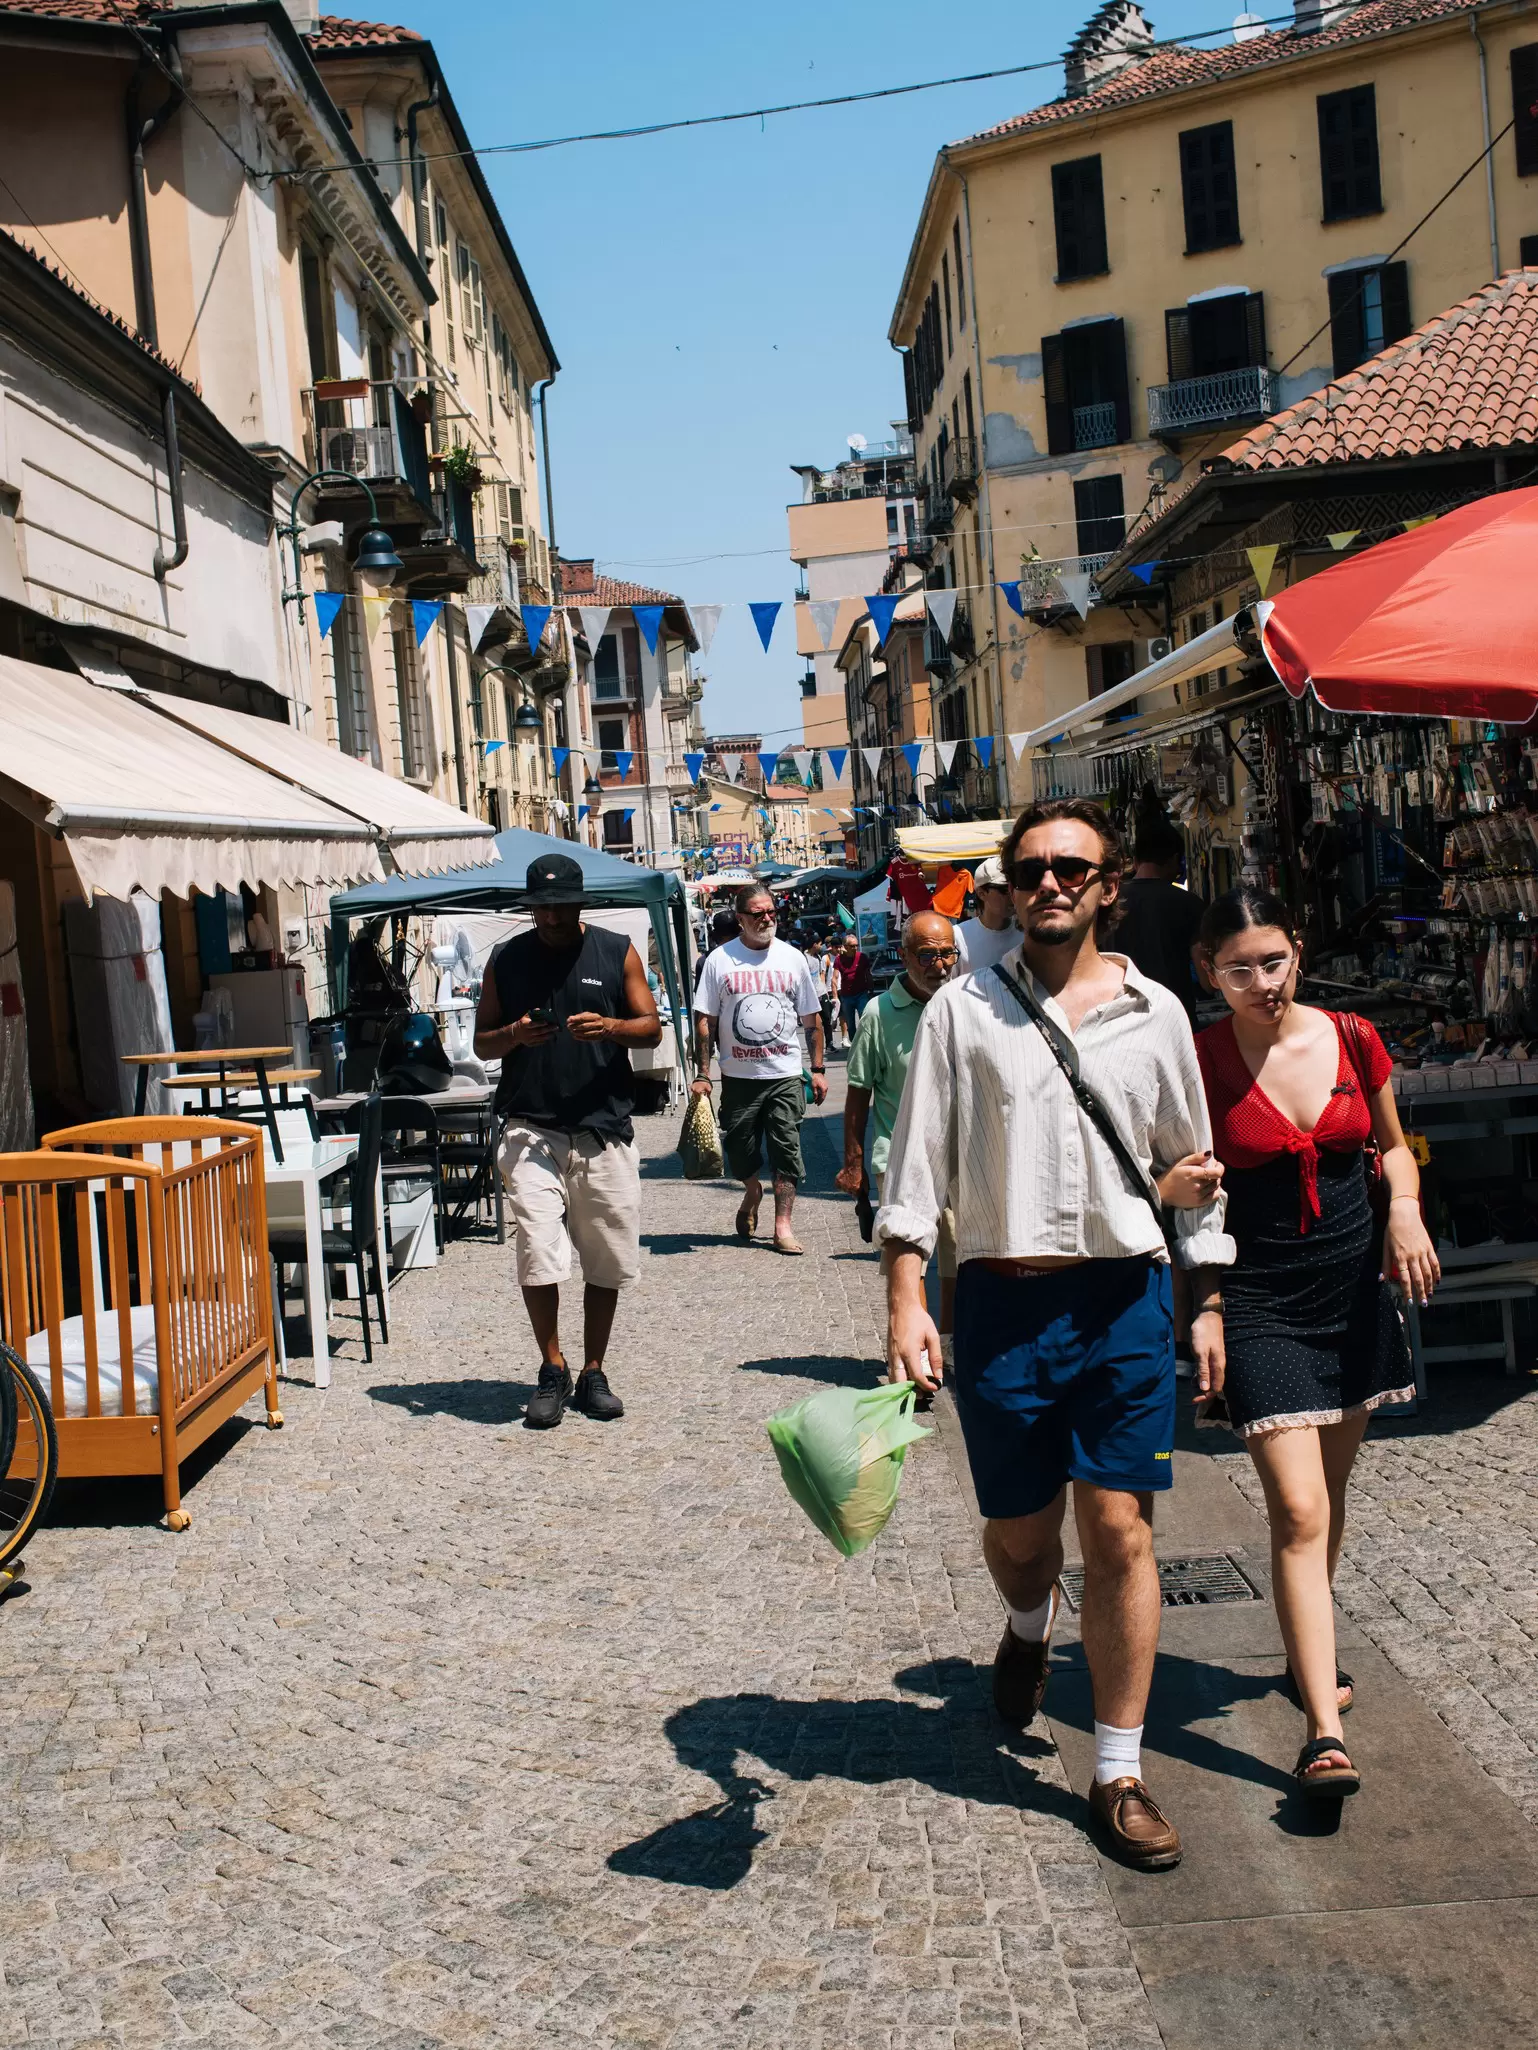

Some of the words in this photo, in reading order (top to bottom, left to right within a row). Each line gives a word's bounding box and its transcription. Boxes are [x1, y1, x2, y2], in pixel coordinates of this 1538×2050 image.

[1376, 832, 1384, 876] PHILIPS
[581, 978, 602, 986] adidas
[723, 970, 795, 995] NIRVANA
